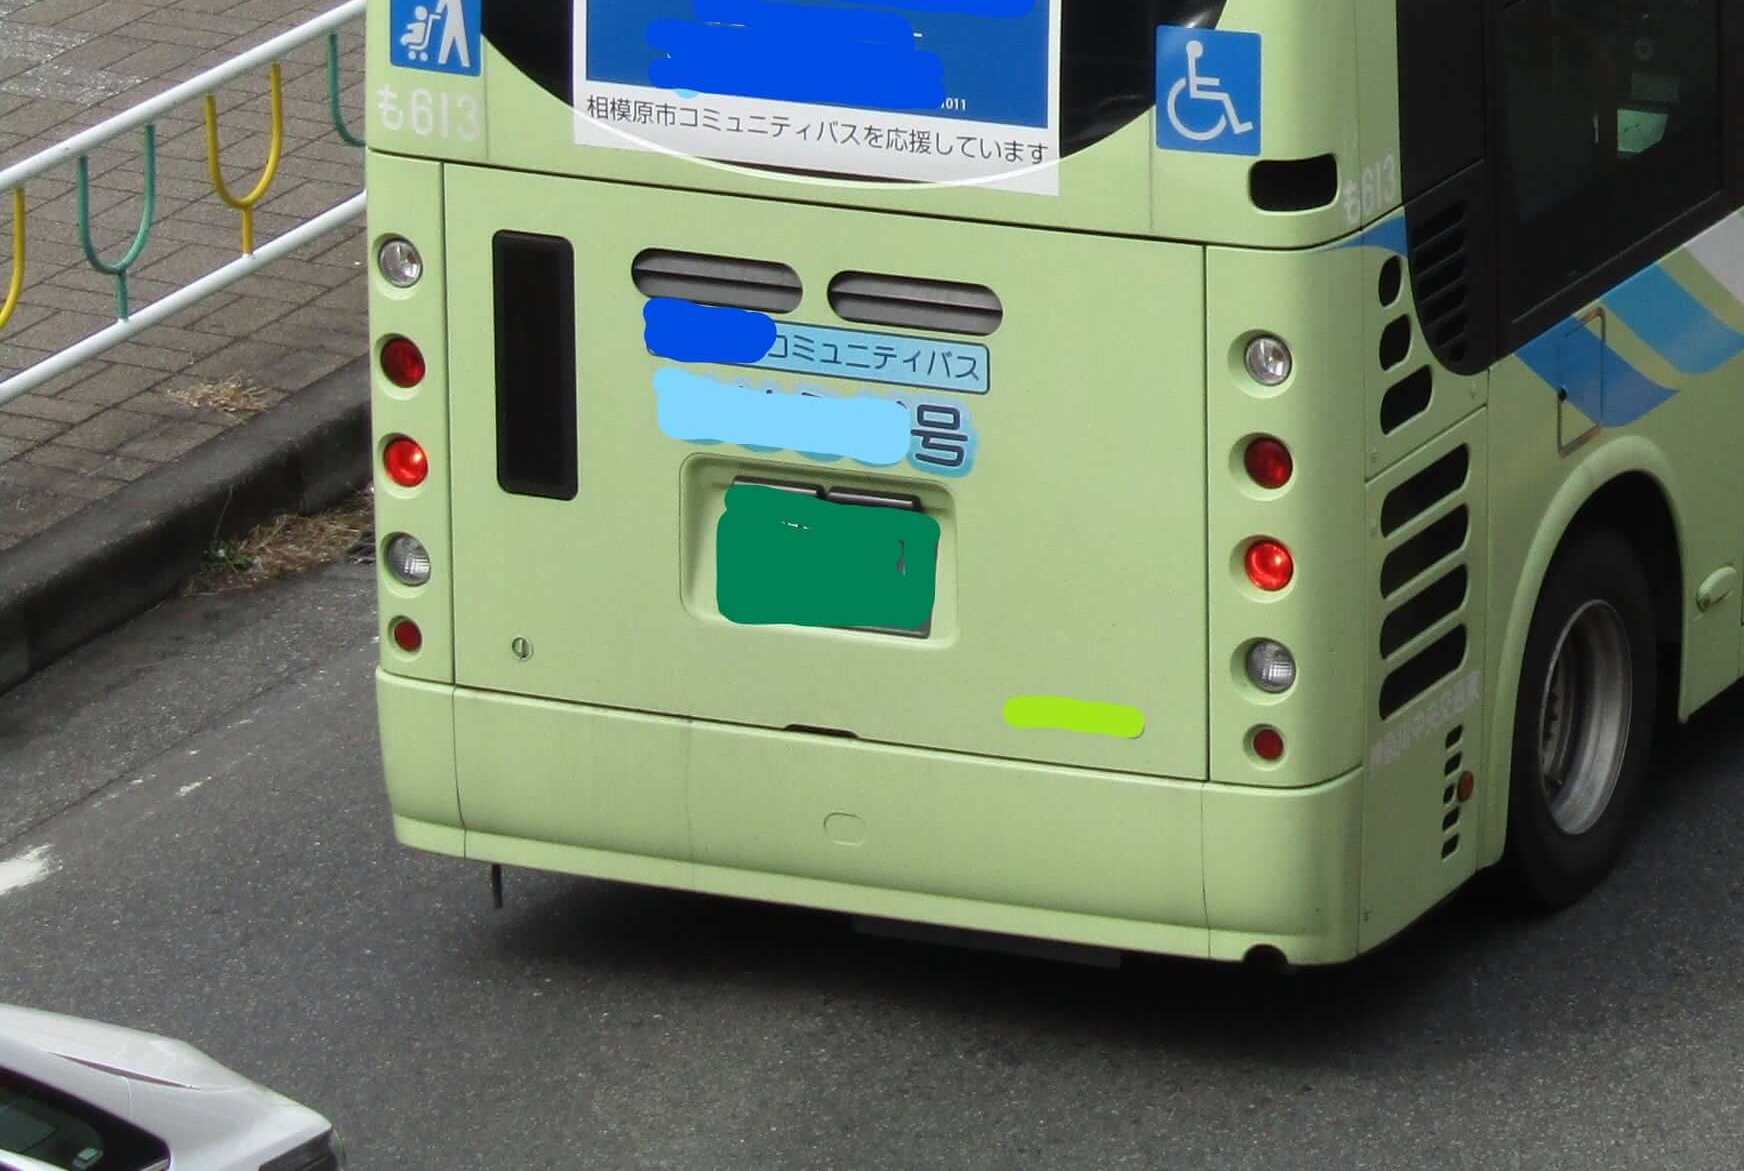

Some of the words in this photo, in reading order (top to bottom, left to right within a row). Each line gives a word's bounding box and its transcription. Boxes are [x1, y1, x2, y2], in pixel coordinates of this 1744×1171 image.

[941, 97, 966, 110] 011
[586, 95, 1048, 165] 相模原市コミュニティバスを応援しています
